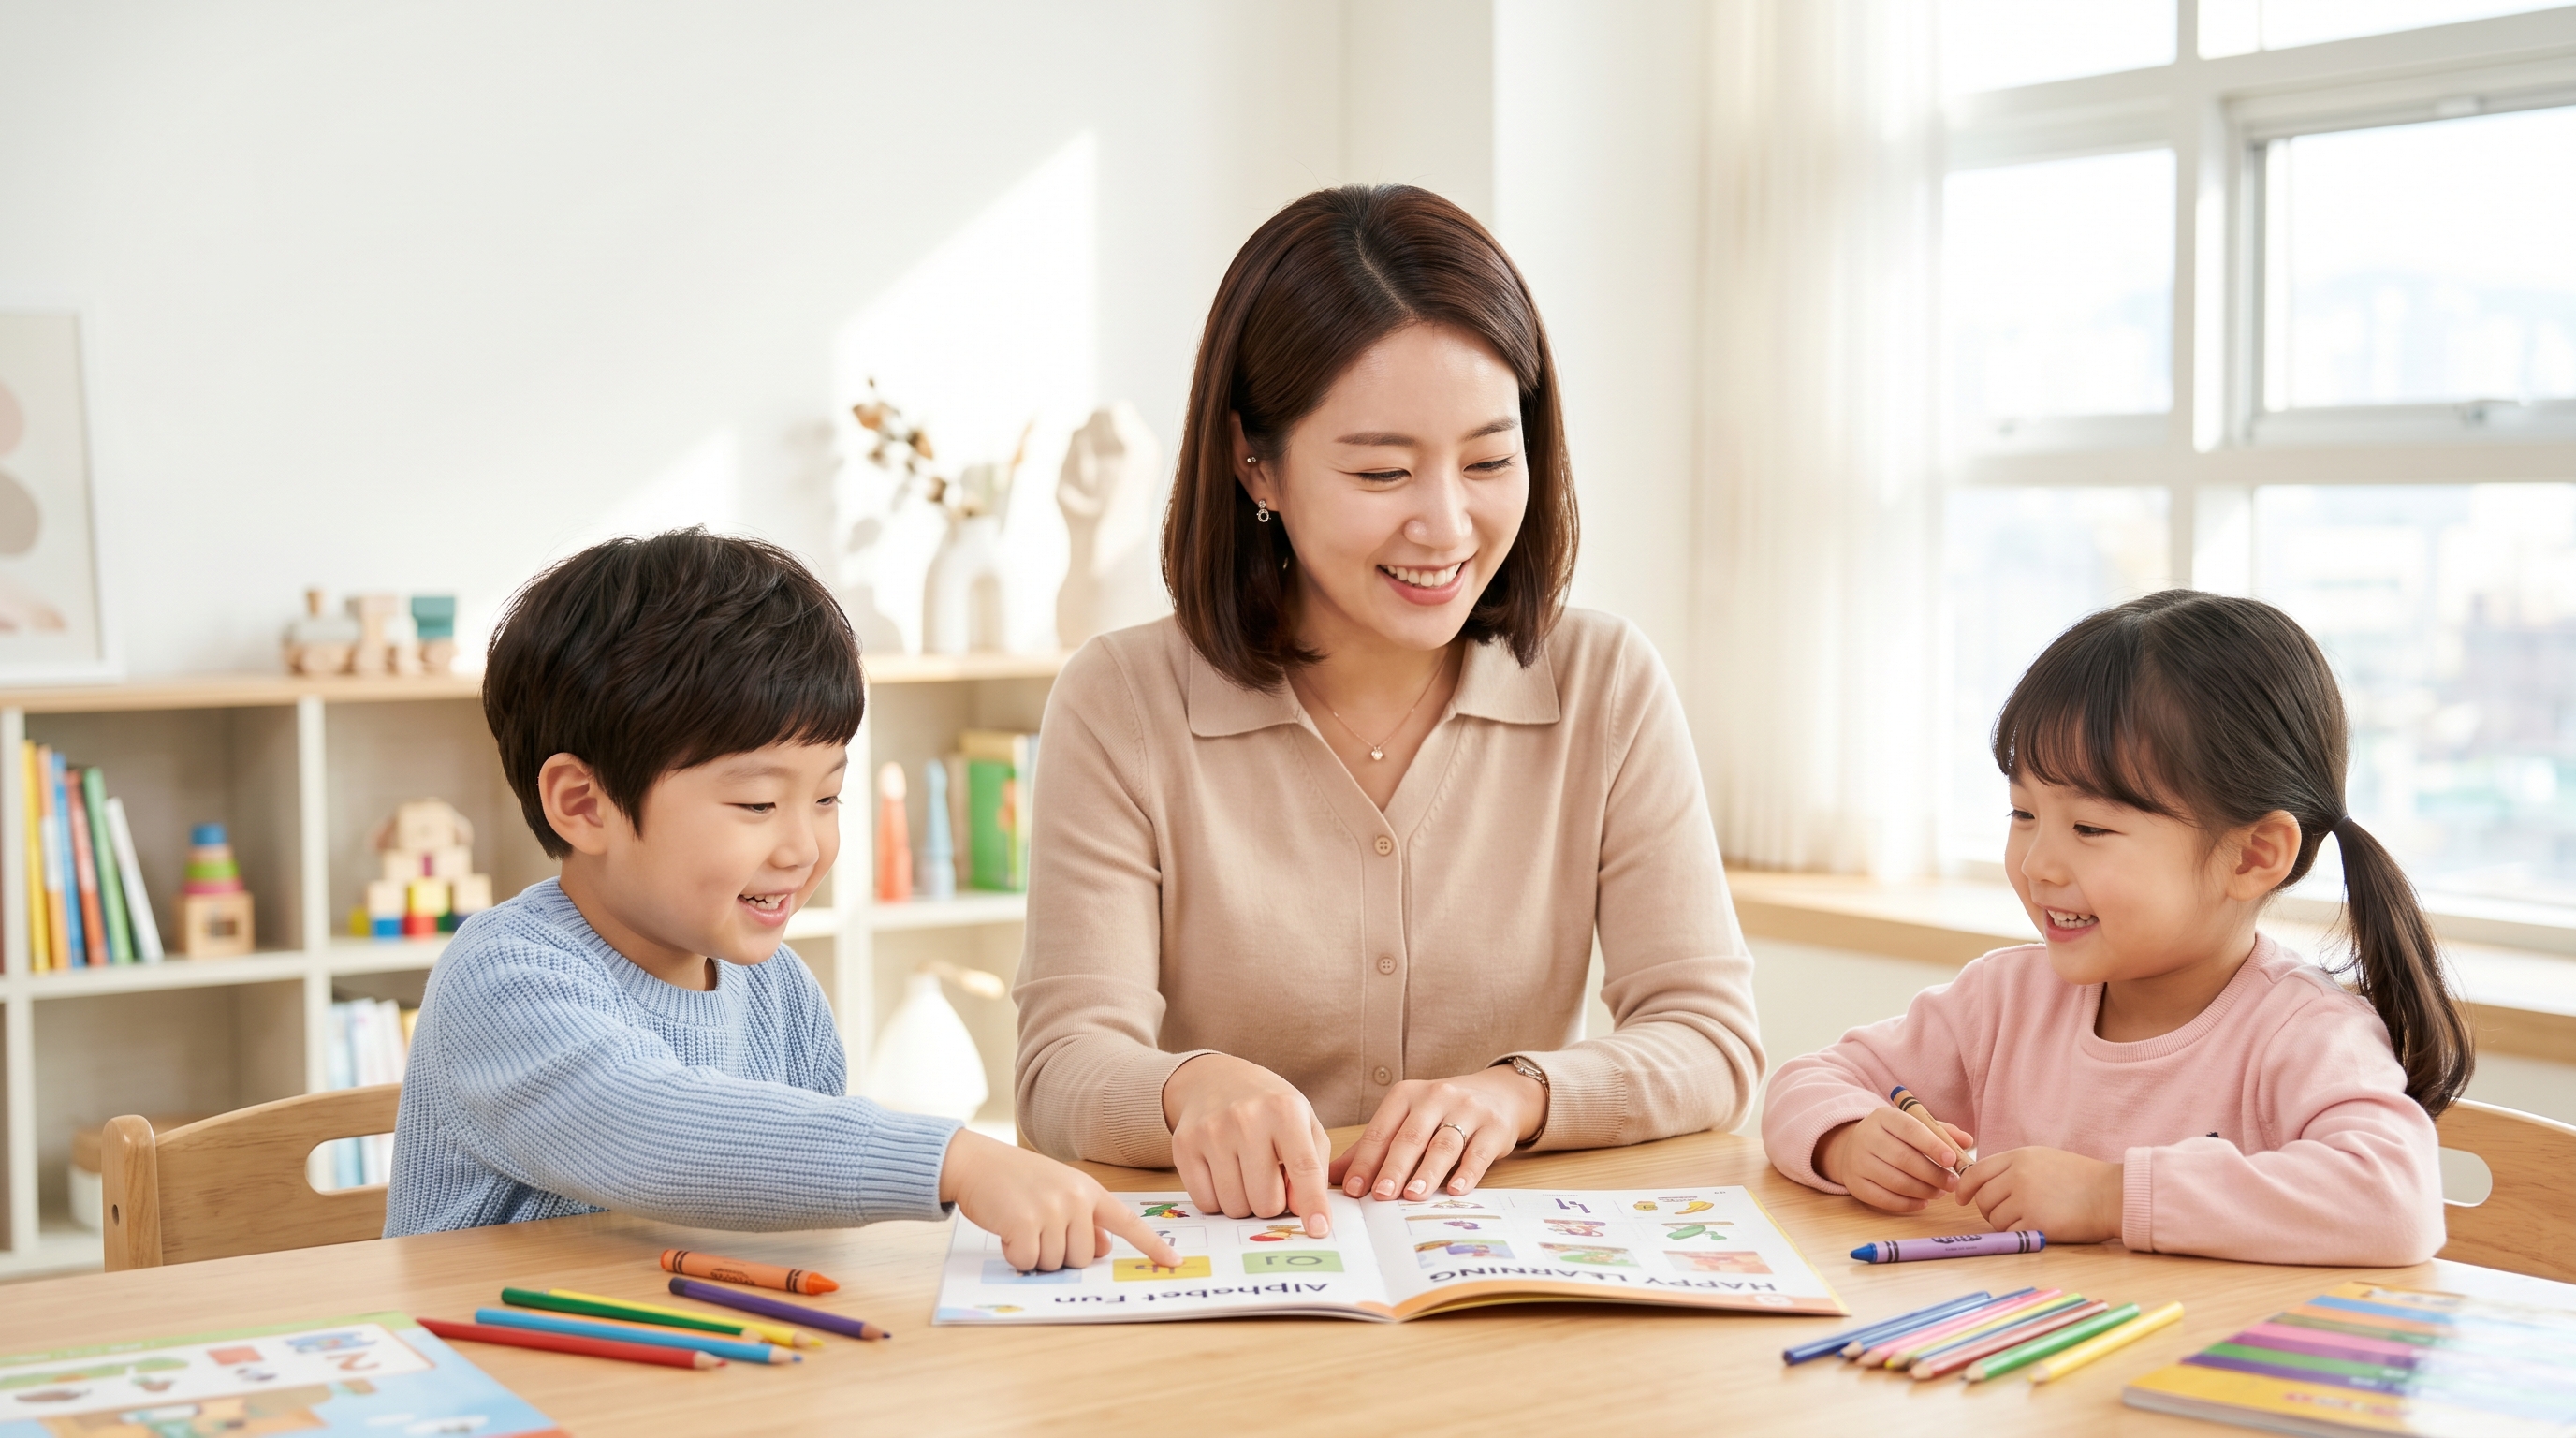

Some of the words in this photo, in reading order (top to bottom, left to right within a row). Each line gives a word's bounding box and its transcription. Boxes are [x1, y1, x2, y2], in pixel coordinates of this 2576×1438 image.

[1142, 1282, 1328, 1301] Alphabet
[1645, 1277, 1777, 1292] HAPPY
[1054, 1294, 1126, 1304] Fun
